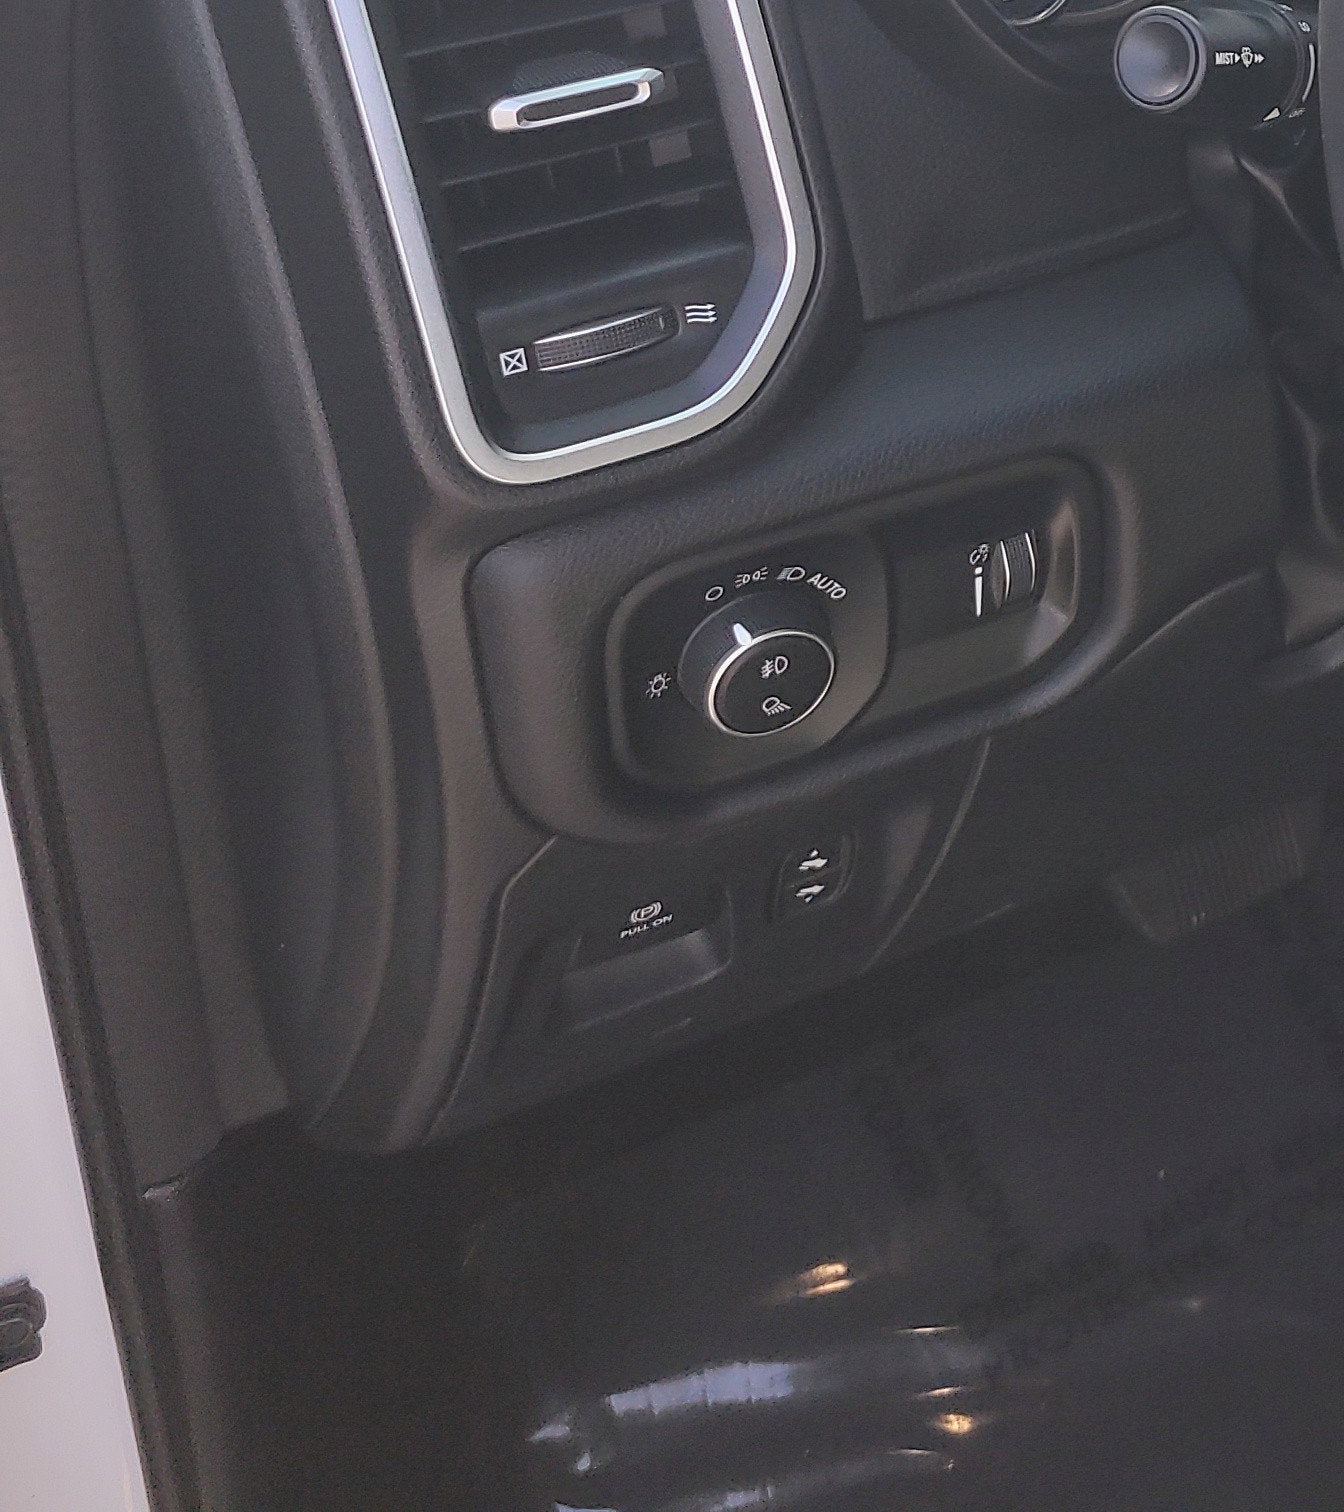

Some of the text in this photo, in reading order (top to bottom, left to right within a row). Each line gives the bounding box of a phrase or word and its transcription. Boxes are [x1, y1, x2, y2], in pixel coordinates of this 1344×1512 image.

[1215, 51, 1235, 65] MIST
[806, 572, 847, 599] AUTO
[620, 913, 673, 939] PULL ON
